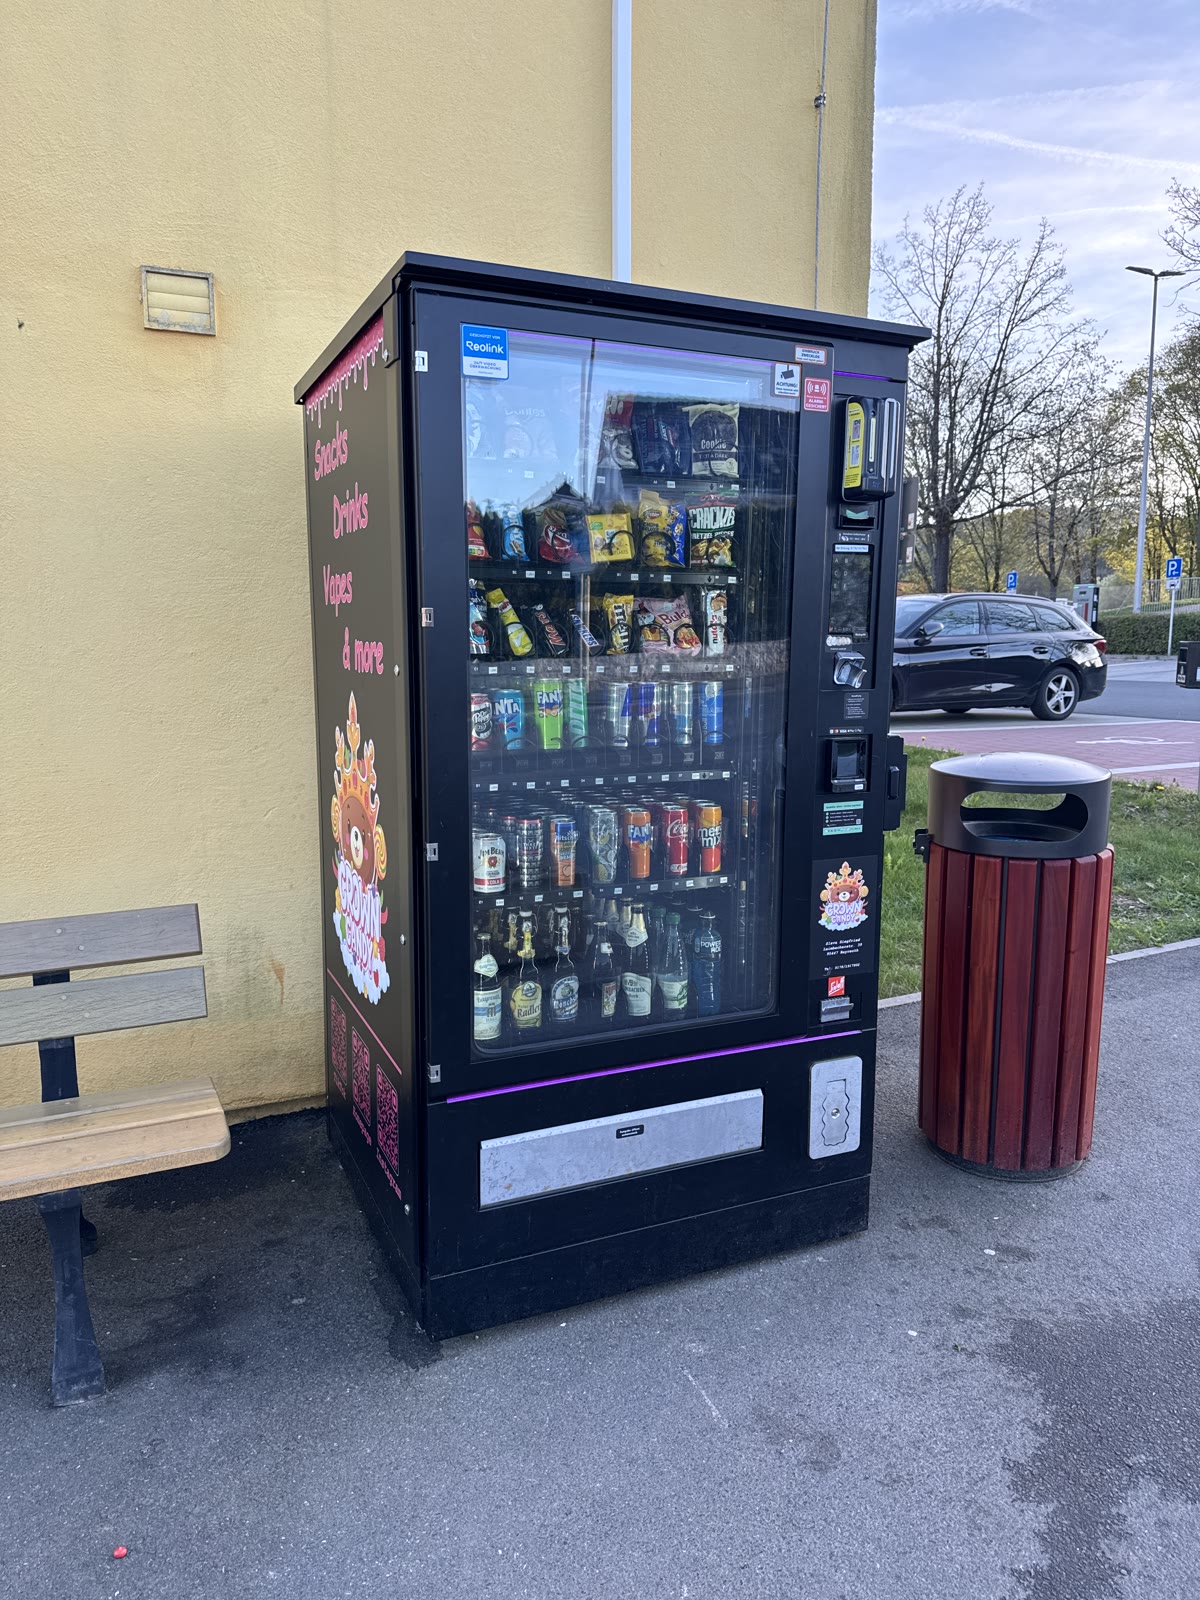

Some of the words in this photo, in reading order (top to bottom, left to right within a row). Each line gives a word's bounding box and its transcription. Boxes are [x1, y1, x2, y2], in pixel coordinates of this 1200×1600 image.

[465, 340, 504, 354] Reolink
[314, 421, 348, 481] Snacks
[333, 482, 369, 539] Drinks
[1008, 574, 1014, 587] P
[1168, 560, 1178, 576] P
[323, 565, 353, 617] Vapes
[342, 627, 350, 671] &
[354, 637, 384, 675] more
[493, 697, 520, 716] NTA
[338, 857, 382, 943] CROWN
[826, 901, 862, 916] CROWN
[831, 913, 856, 925] CANDY
[345, 916, 373, 978] CANDY
